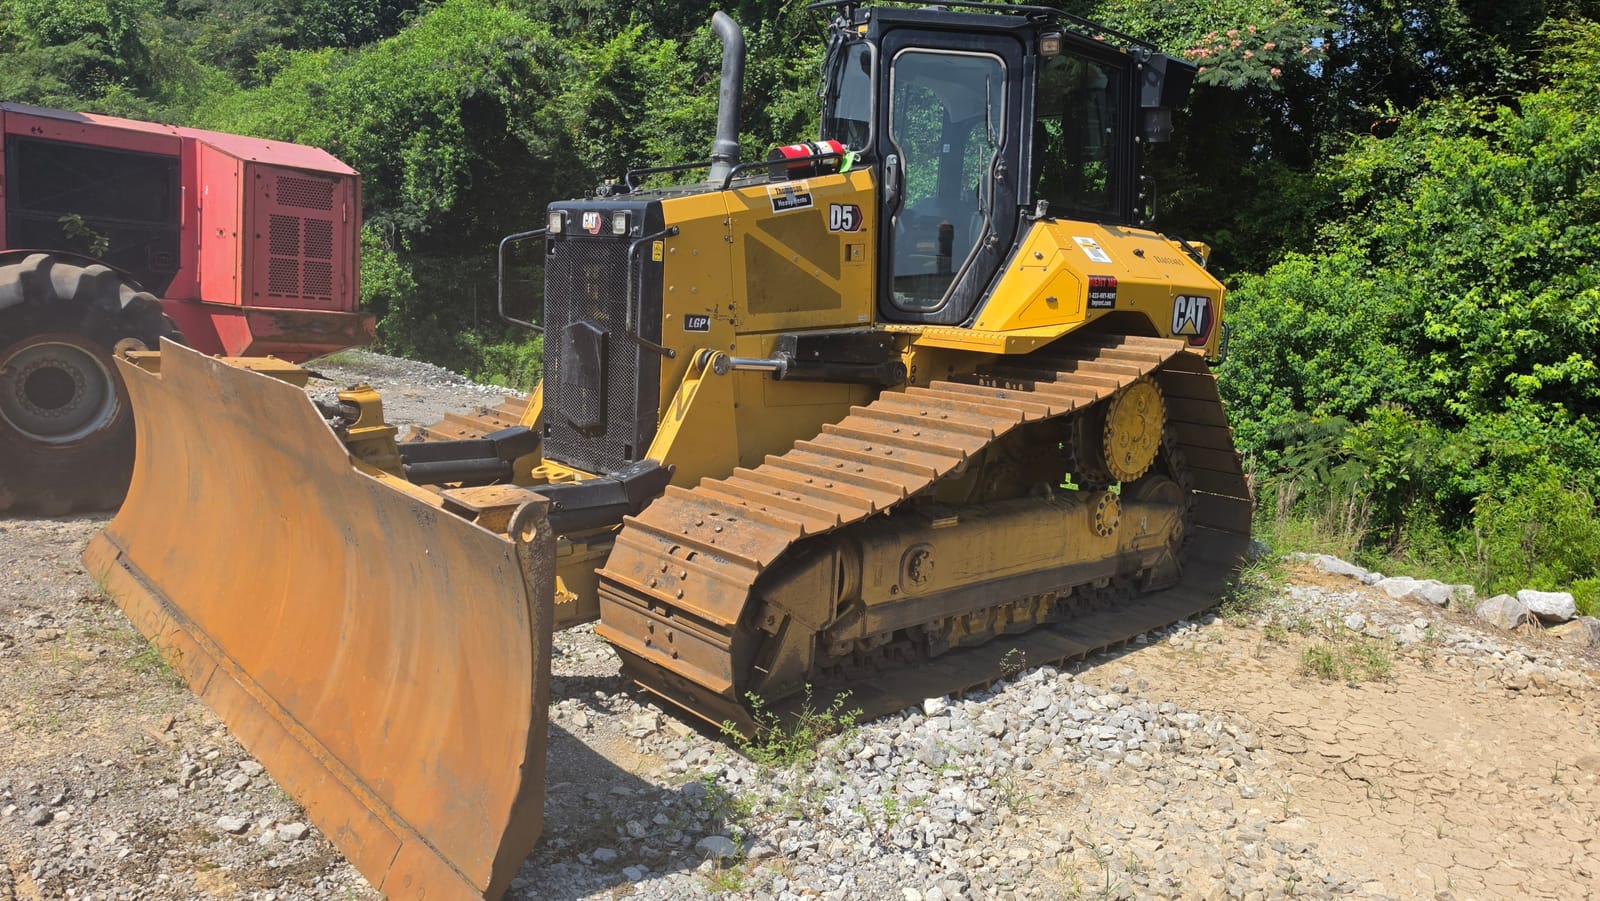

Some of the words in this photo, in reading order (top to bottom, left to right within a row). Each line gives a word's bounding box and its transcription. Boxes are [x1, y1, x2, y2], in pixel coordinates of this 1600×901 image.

[583, 212, 598, 229] CAT
[830, 204, 852, 230] D5
[688, 317, 707, 328] LGP
[1172, 295, 1207, 335] CAT
